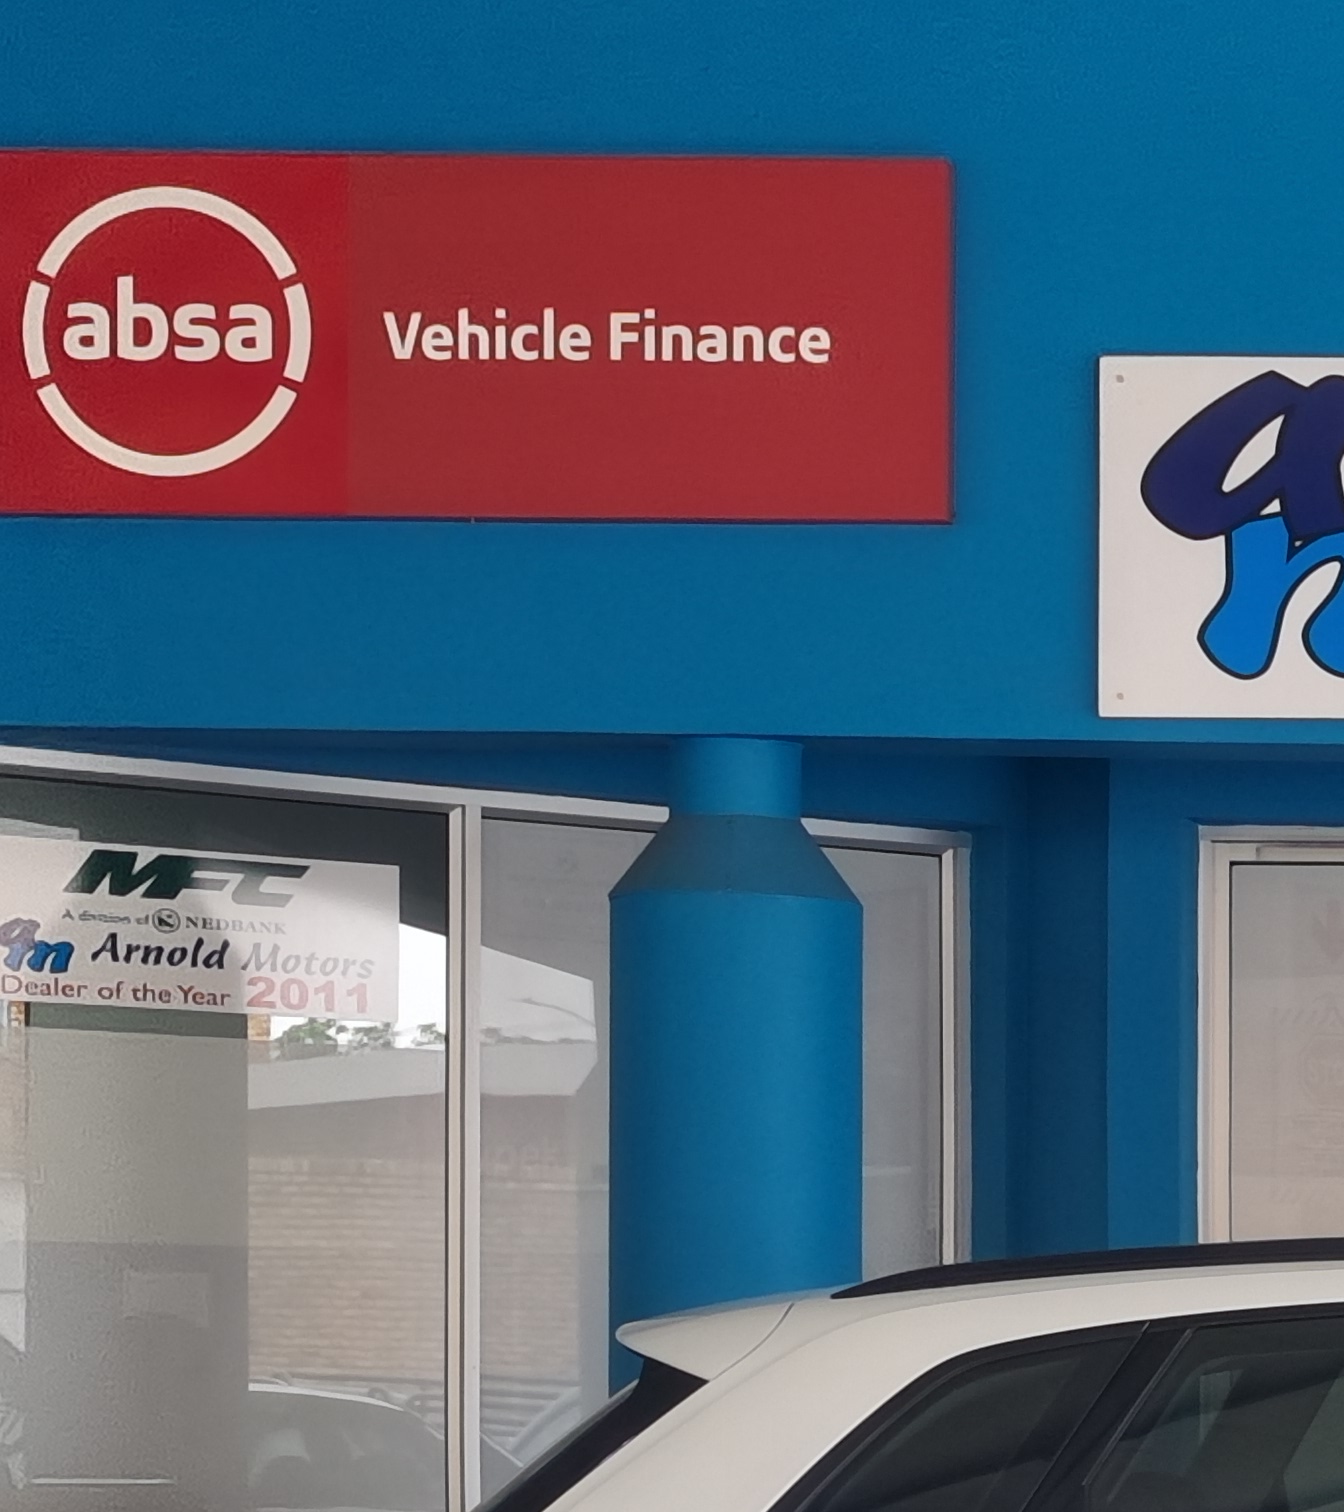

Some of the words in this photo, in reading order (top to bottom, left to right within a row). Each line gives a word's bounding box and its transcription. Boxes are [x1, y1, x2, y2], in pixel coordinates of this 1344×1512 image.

[63, 275, 273, 362] absa
[383, 307, 591, 361] Vehicle
[609, 308, 831, 363] Finance
[63, 849, 310, 908] MFC
[185, 916, 287, 935] NEDBANK
[91, 932, 230, 970] Arnold
[241, 942, 375, 979] Motors
[2, 974, 88, 998] Dealer
[97, 980, 124, 1000] of
[131, 983, 172, 1004] the
[177, 984, 231, 1007] Year
[246, 976, 368, 1014] 2011
